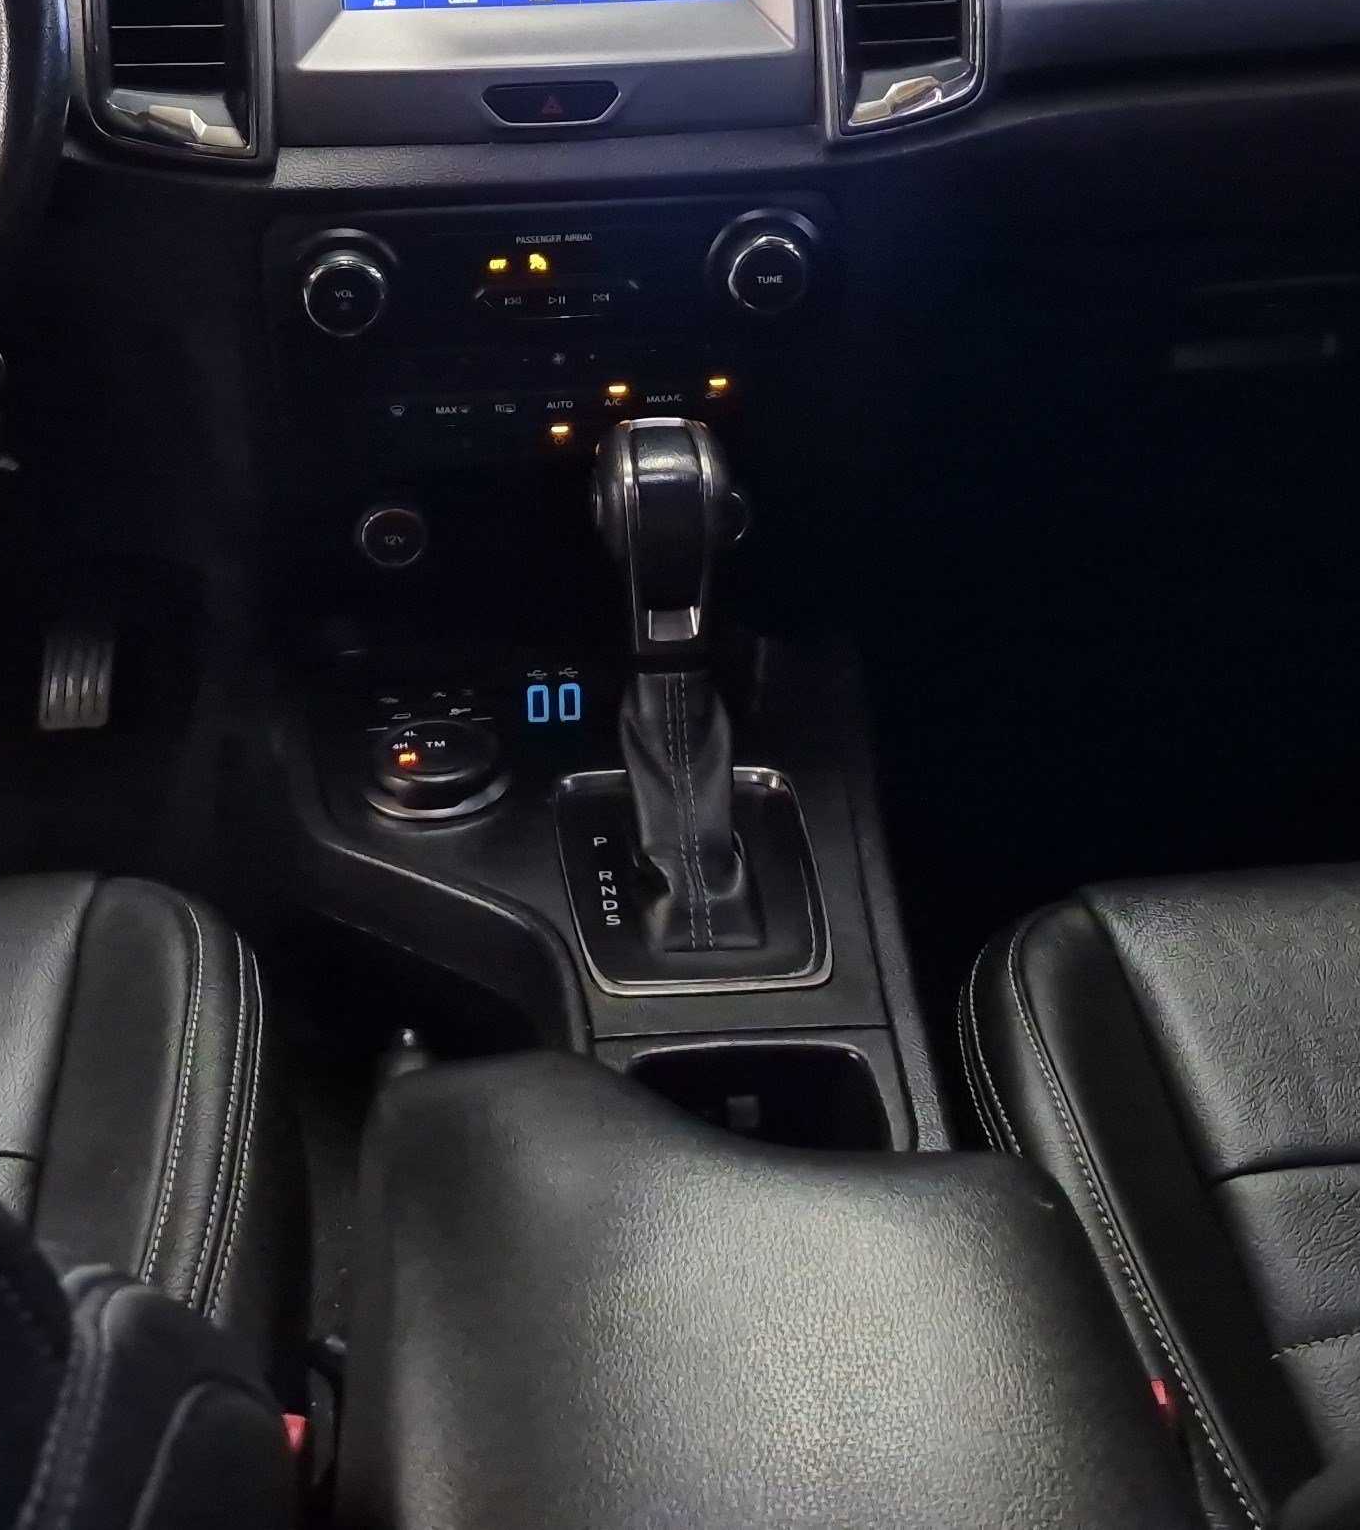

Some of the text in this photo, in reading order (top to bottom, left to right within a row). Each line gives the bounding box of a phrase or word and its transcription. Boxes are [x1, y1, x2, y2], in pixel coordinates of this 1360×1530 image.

[515, 233, 593, 244] PASSENGER AIRBAG
[756, 274, 783, 286] TUNE
[334, 290, 354, 299] VOL
[604, 398, 623, 408] A/C
[646, 393, 683, 404] MAX A/C
[435, 405, 457, 415] MAX
[546, 400, 574, 410] AUTO
[391, 741, 409, 750] 4H
[425, 740, 446, 749] TM
[593, 836, 608, 847] P
[598, 870, 613, 882] R
[600, 884, 617, 897] N
[602, 899, 619, 911] D
[605, 914, 621, 926] S
